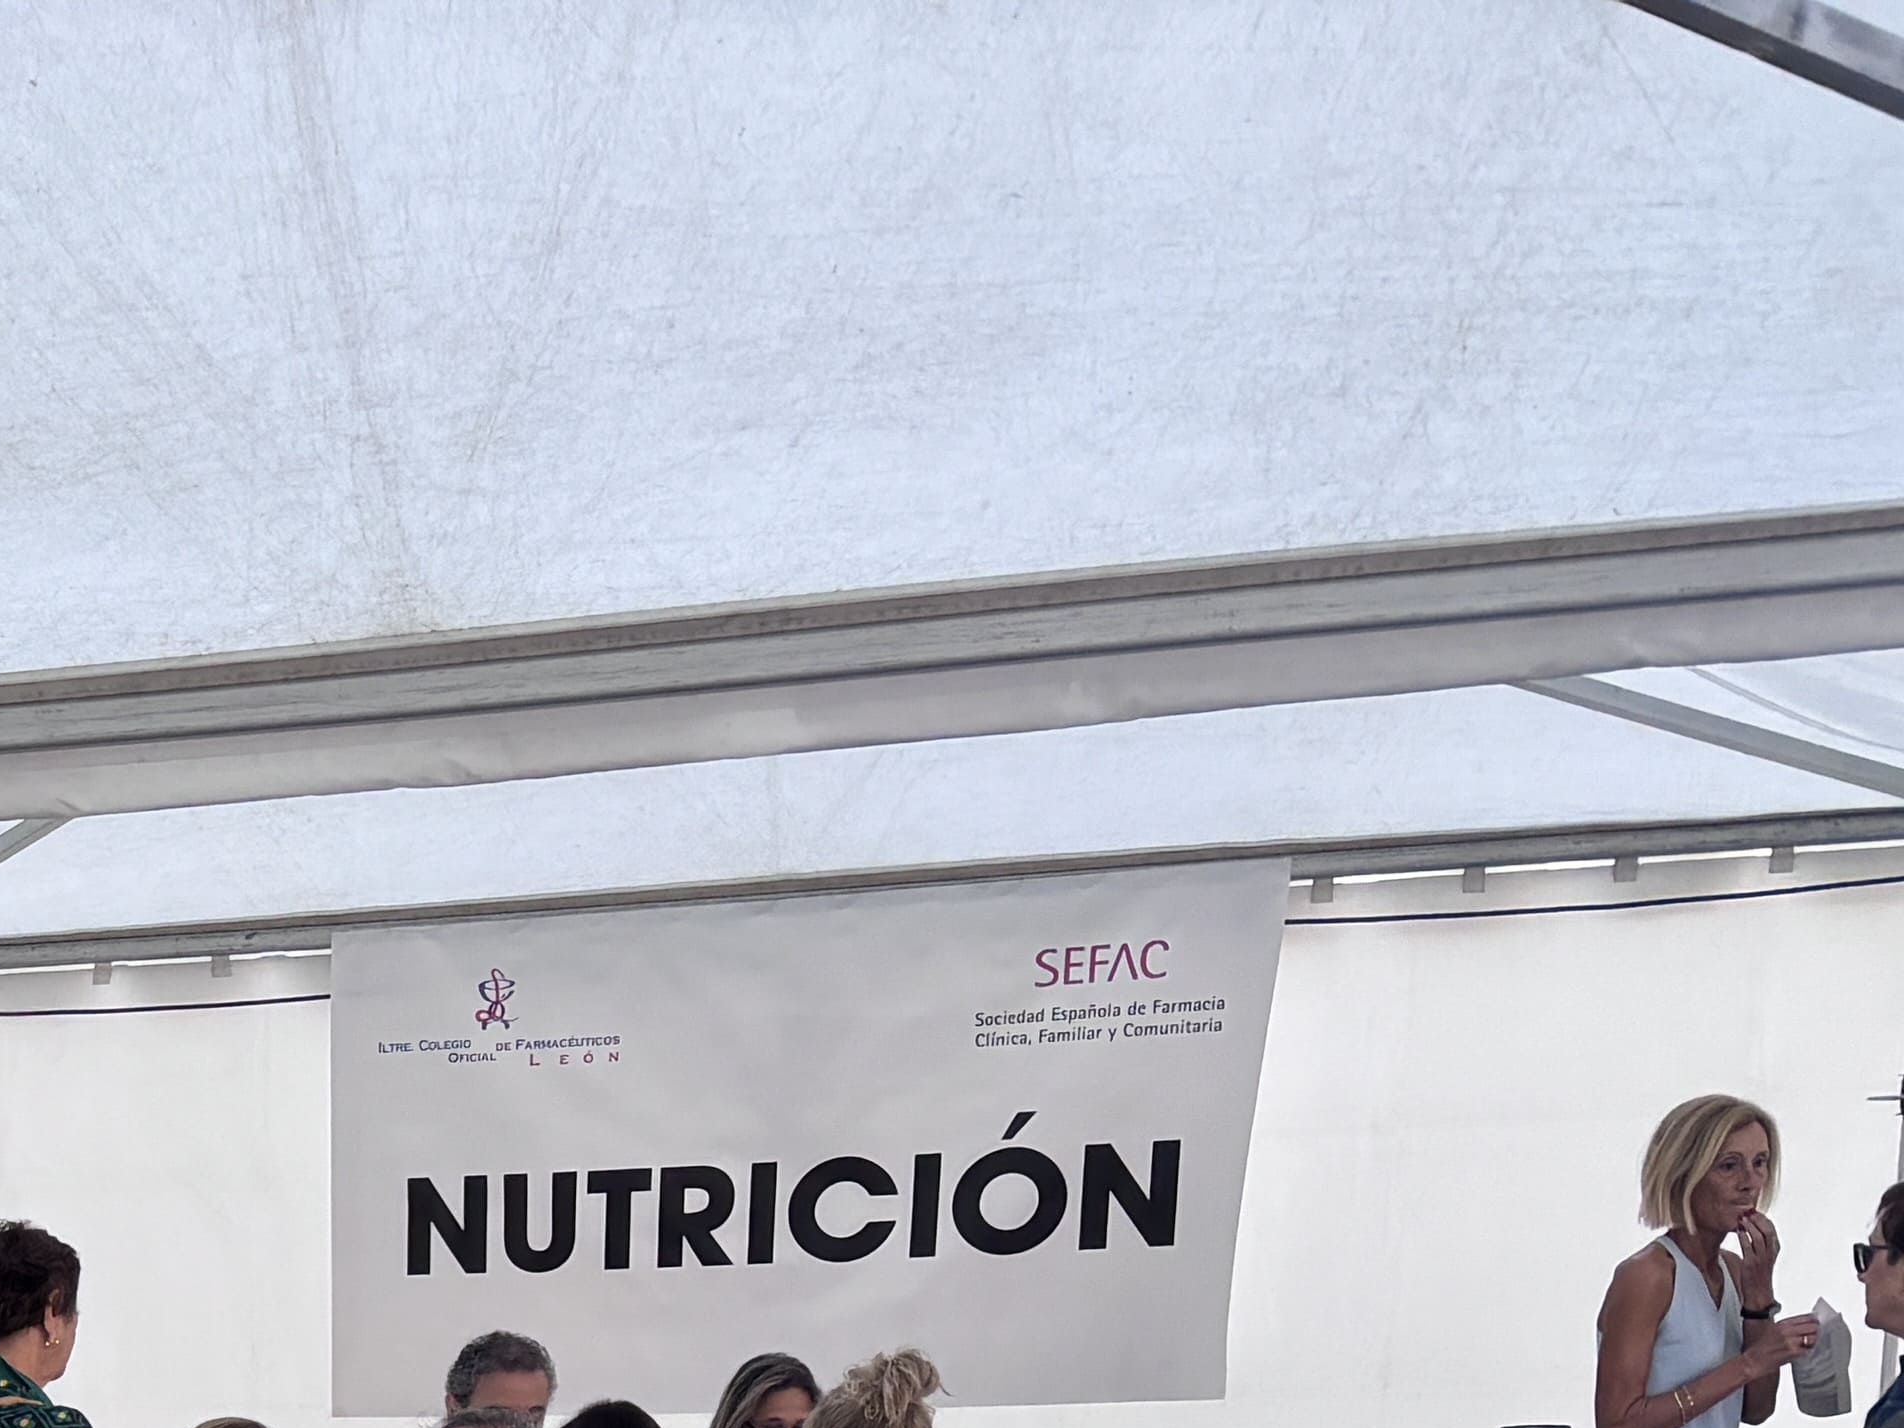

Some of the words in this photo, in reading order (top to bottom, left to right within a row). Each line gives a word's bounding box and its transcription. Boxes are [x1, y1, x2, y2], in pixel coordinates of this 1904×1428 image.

[1034, 939, 1171, 989] SEFAC
[974, 1009, 1045, 1028] Sociedad
[1050, 1003, 1122, 1025] Española
[1127, 1001, 1147, 1016] de
[1152, 995, 1226, 1014] Farmacia
[975, 1031, 1032, 1048] Clínica,
[1038, 1025, 1102, 1044] Familiar
[1108, 1027, 1117, 1042] y
[1123, 1017, 1223, 1038] Comunitaria
[405, 1110, 1184, 1278] NUTRICIÓN
